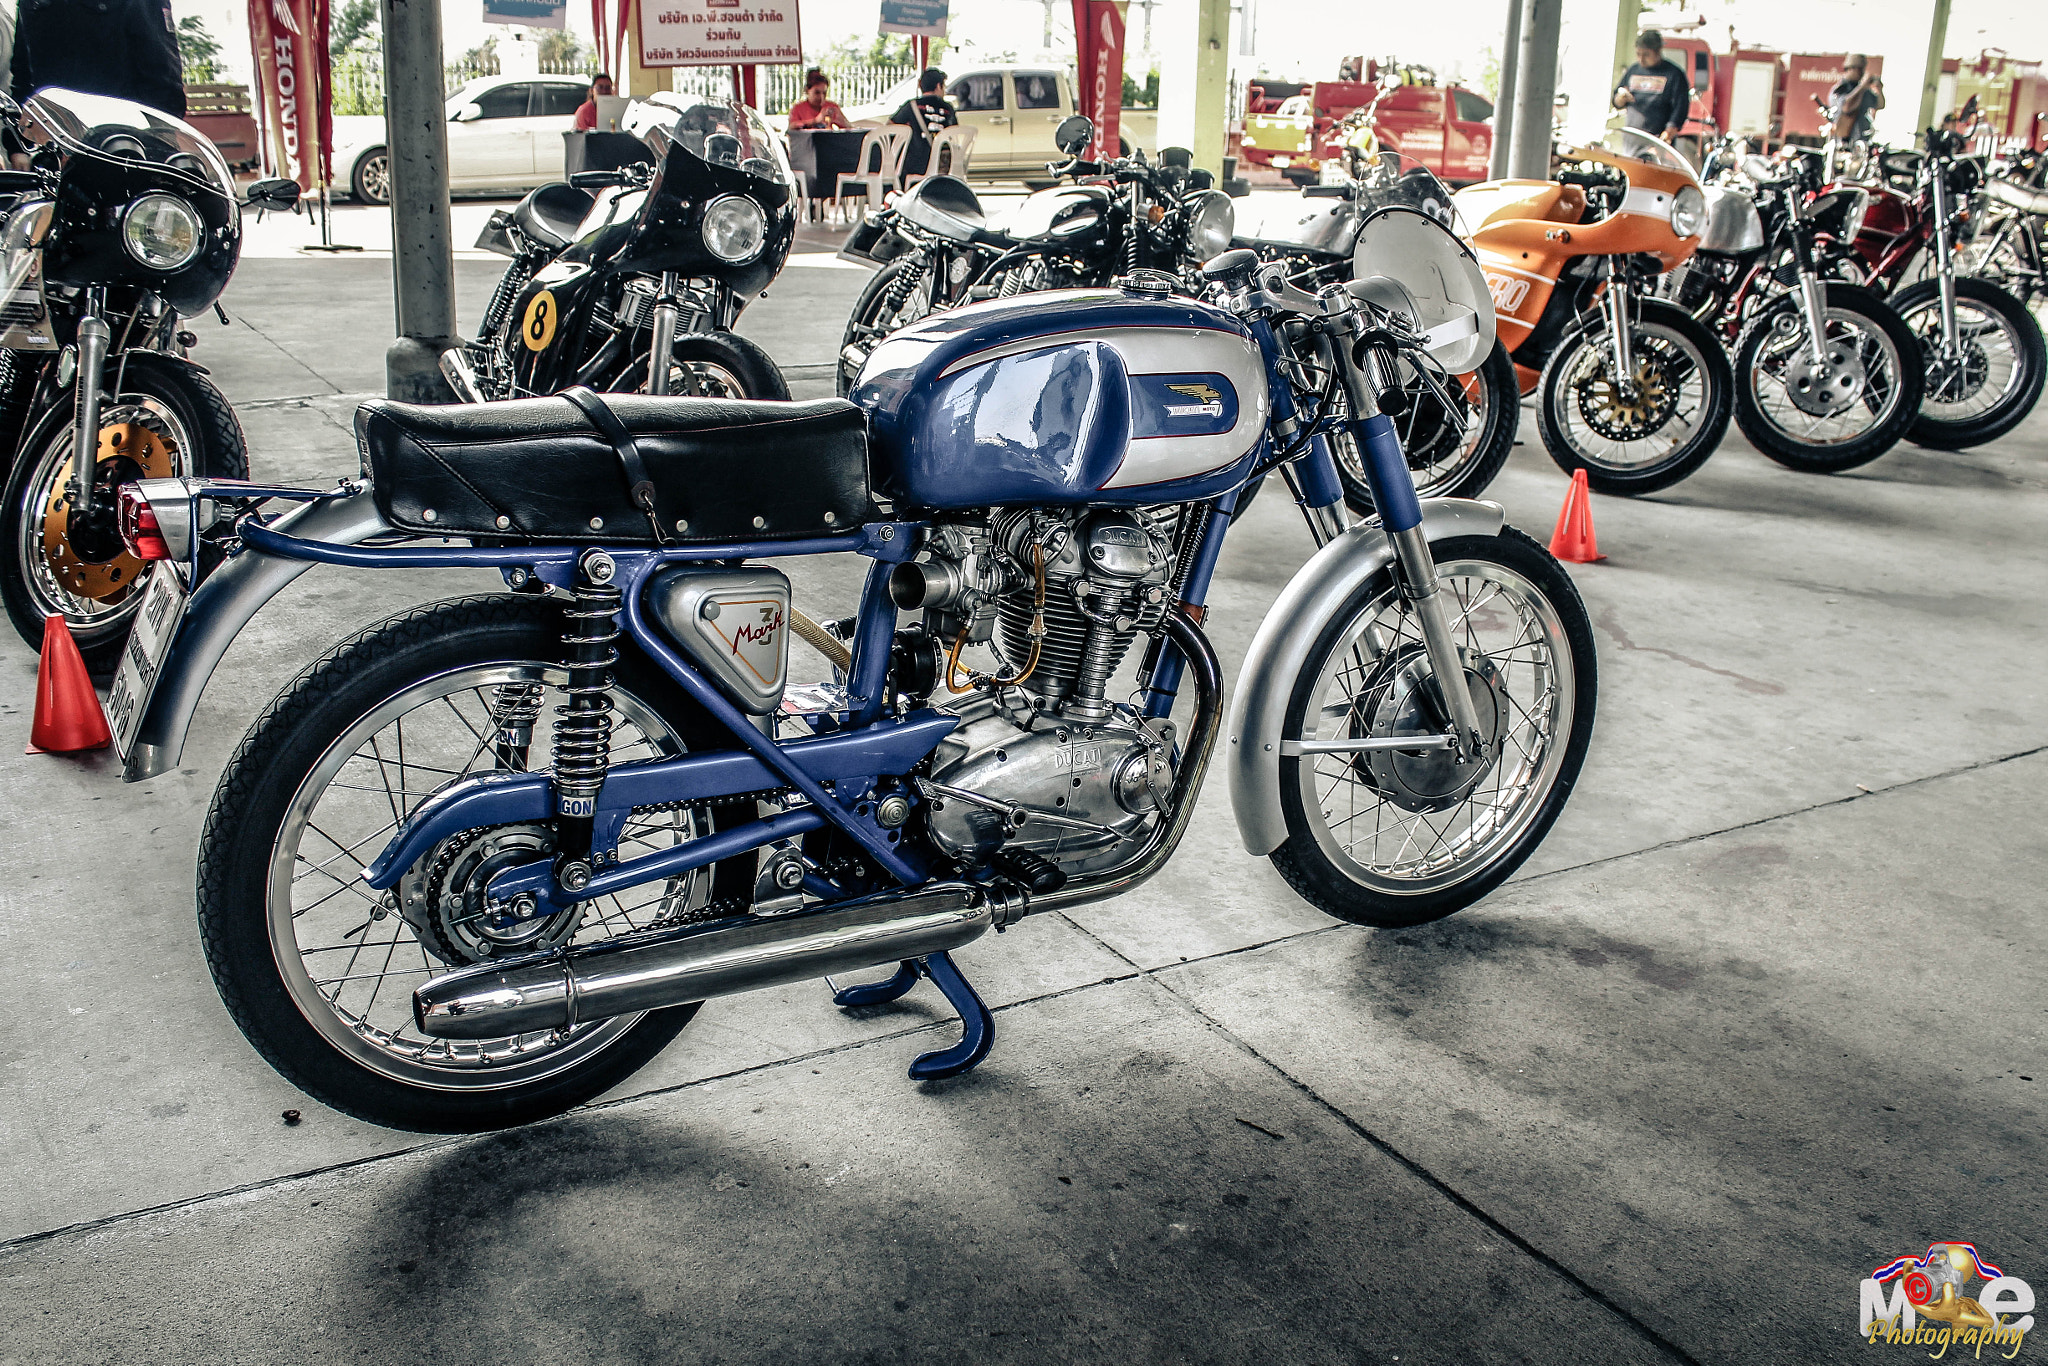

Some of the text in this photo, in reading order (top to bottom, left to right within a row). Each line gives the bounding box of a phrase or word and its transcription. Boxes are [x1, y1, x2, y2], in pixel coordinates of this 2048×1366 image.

[658, 10, 689, 24] บริษัท
[757, 8, 783, 22] จำกัด
[706, 27, 741, 41] ร่วมกับ
[646, 47, 673, 60] บริษัท
[775, 44, 798, 57] จำกัด
[274, 35, 301, 181] HONDA
[530, 299, 548, 341] 8
[1103, 529, 1148, 547] DUCATI
[732, 610, 785, 656] Mark
[1055, 747, 1102, 769] DUCATI
